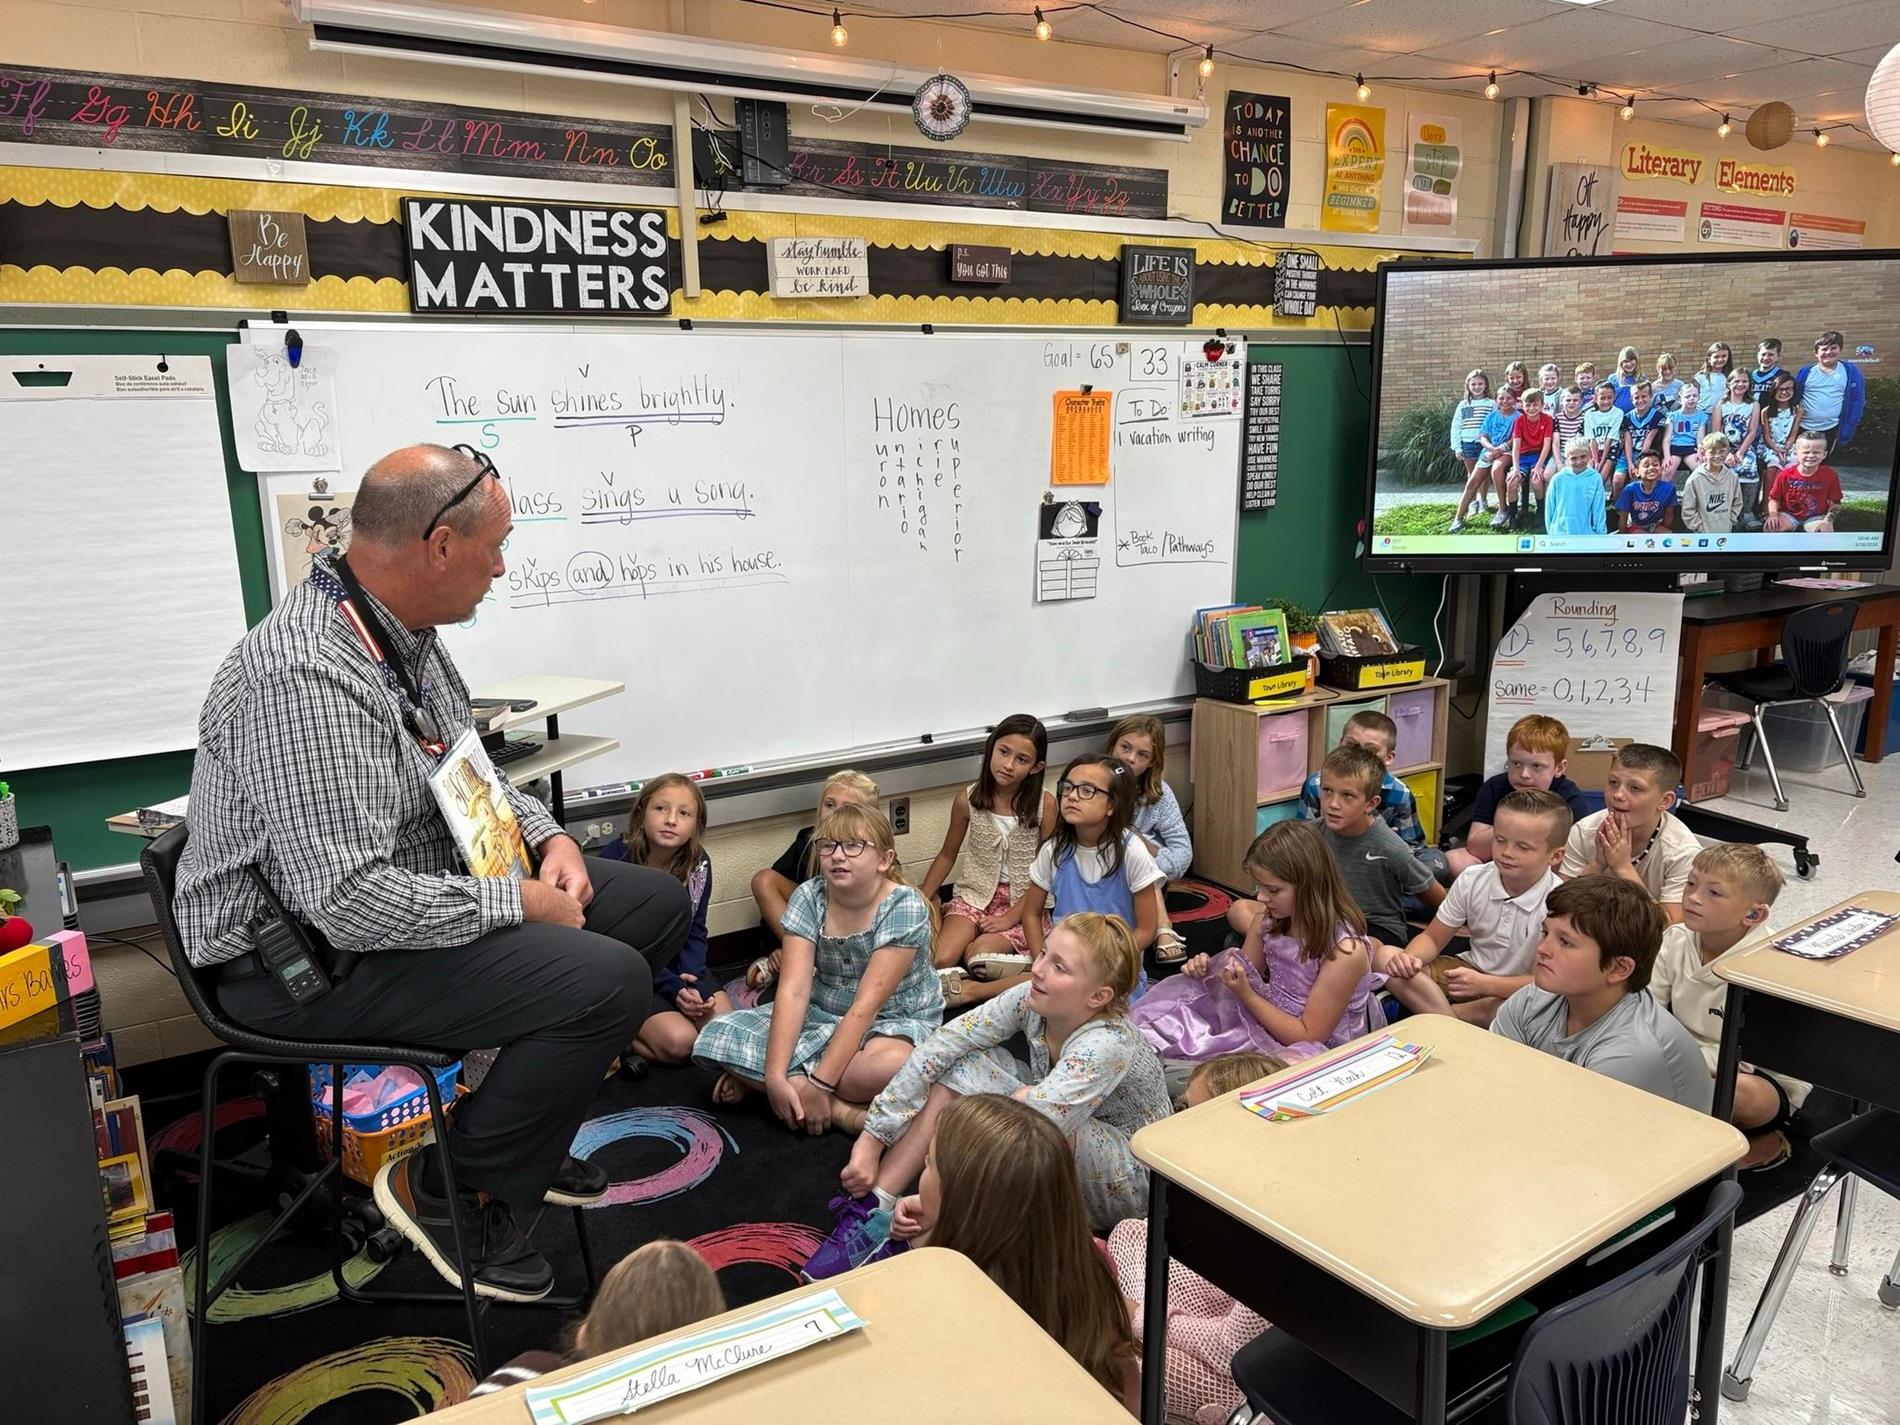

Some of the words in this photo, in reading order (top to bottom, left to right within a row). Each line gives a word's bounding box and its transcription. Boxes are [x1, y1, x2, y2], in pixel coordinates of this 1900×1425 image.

[1233, 102, 1284, 126] TODAY
[69, 86, 129, 144] Gg
[145, 91, 200, 132] Hh
[216, 102, 259, 140] Ii
[283, 107, 323, 160] Jj
[343, 111, 395, 150] Kk
[402, 118, 457, 154] Ll
[463, 120, 546, 162] Mm
[563, 130, 620, 167] Nn
[629, 136, 669, 172] Oo
[1231, 140, 1285, 165] CHANCE
[1334, 155, 1380, 169] EXPERT
[1344, 172, 1375, 181] ANYTHING
[1627, 145, 1703, 185] Literary
[1719, 160, 1795, 195] Elements
[832, 157, 864, 187] Ss
[905, 161, 942, 192] Uu
[947, 165, 976, 194] Vv
[980, 166, 1024, 198] Ww
[1031, 172, 1062, 201] Xx
[1066, 174, 1100, 212] Yy
[1103, 177, 1130, 215] Zz
[1234, 173, 1248, 186] TO
[1251, 167, 1283, 197] DO
[1229, 198, 1282, 220] BETTER
[1329, 195, 1375, 208] BEGINNER
[258, 213, 288, 250] Be
[411, 203, 666, 258] KINDNESS
[1562, 203, 1610, 257] Happy
[781, 240, 814, 264] stay
[816, 239, 862, 259] humble
[1286, 254, 1299, 269] ONE
[1300, 255, 1318, 270] SMALL
[240, 249, 303, 281] Happy
[796, 266, 822, 276] WORK
[824, 266, 850, 276] HARD
[1133, 254, 1170, 276] LIFE
[1174, 256, 1188, 277] IS
[416, 259, 668, 311] MATTERS
[790, 277, 814, 293] be
[816, 275, 859, 294] kind
[1138, 284, 1181, 300] WHOLE
[1150, 300, 1159, 316] of
[1159, 300, 1187, 316] Crayons
[1285, 300, 1303, 314] WHOLE
[1304, 301, 1316, 315] DAY
[1043, 343, 1072, 367] Goal
[1090, 344, 1114, 369] 65
[1141, 348, 1169, 375] 33
[1251, 374, 1261, 385] WE
[1261, 374, 1281, 385] SHARE
[1257, 364, 1268, 374] THIS
[1268, 364, 1282, 373] CLASS
[426, 375, 480, 417] The
[497, 388, 536, 414] sun
[552, 380, 624, 414] shines
[640, 374, 736, 427] brightly.
[1065, 398, 1090, 406] Character
[1250, 396, 1261, 406] SAY
[1261, 396, 1280, 406] SORRY
[1251, 386, 1264, 396] TAKE
[1264, 386, 1280, 396] TURNS
[1129, 400, 1143, 417] To
[480, 423, 500, 449] S
[625, 425, 643, 447] P
[1129, 429, 1172, 446] vacation
[1178, 426, 1215, 451] writing
[1248, 443, 1265, 454] HAVE
[1265, 442, 1278, 454] FUN
[1264, 480, 1277, 489] BEST
[509, 477, 563, 515] lass
[582, 484, 646, 526] sings
[669, 489, 682, 505] a
[695, 478, 754, 520] song.
[1709, 493, 1726, 504] NIKE
[1131, 531, 1154, 545] Book
[1136, 543, 1158, 556] Taco
[509, 561, 561, 607] skips
[572, 560, 610, 585] and
[619, 550, 658, 600] hops
[669, 558, 690, 578] in
[700, 547, 724, 575] his
[732, 546, 782, 572] house.
[1549, 596, 1619, 626] Rounding
[1391, 669, 1413, 678] Library
[1262, 684, 1278, 692] Town
[1277, 681, 1297, 690] Library
[621, 1367, 681, 1405] Stella
[804, 1320, 823, 1334] 7
